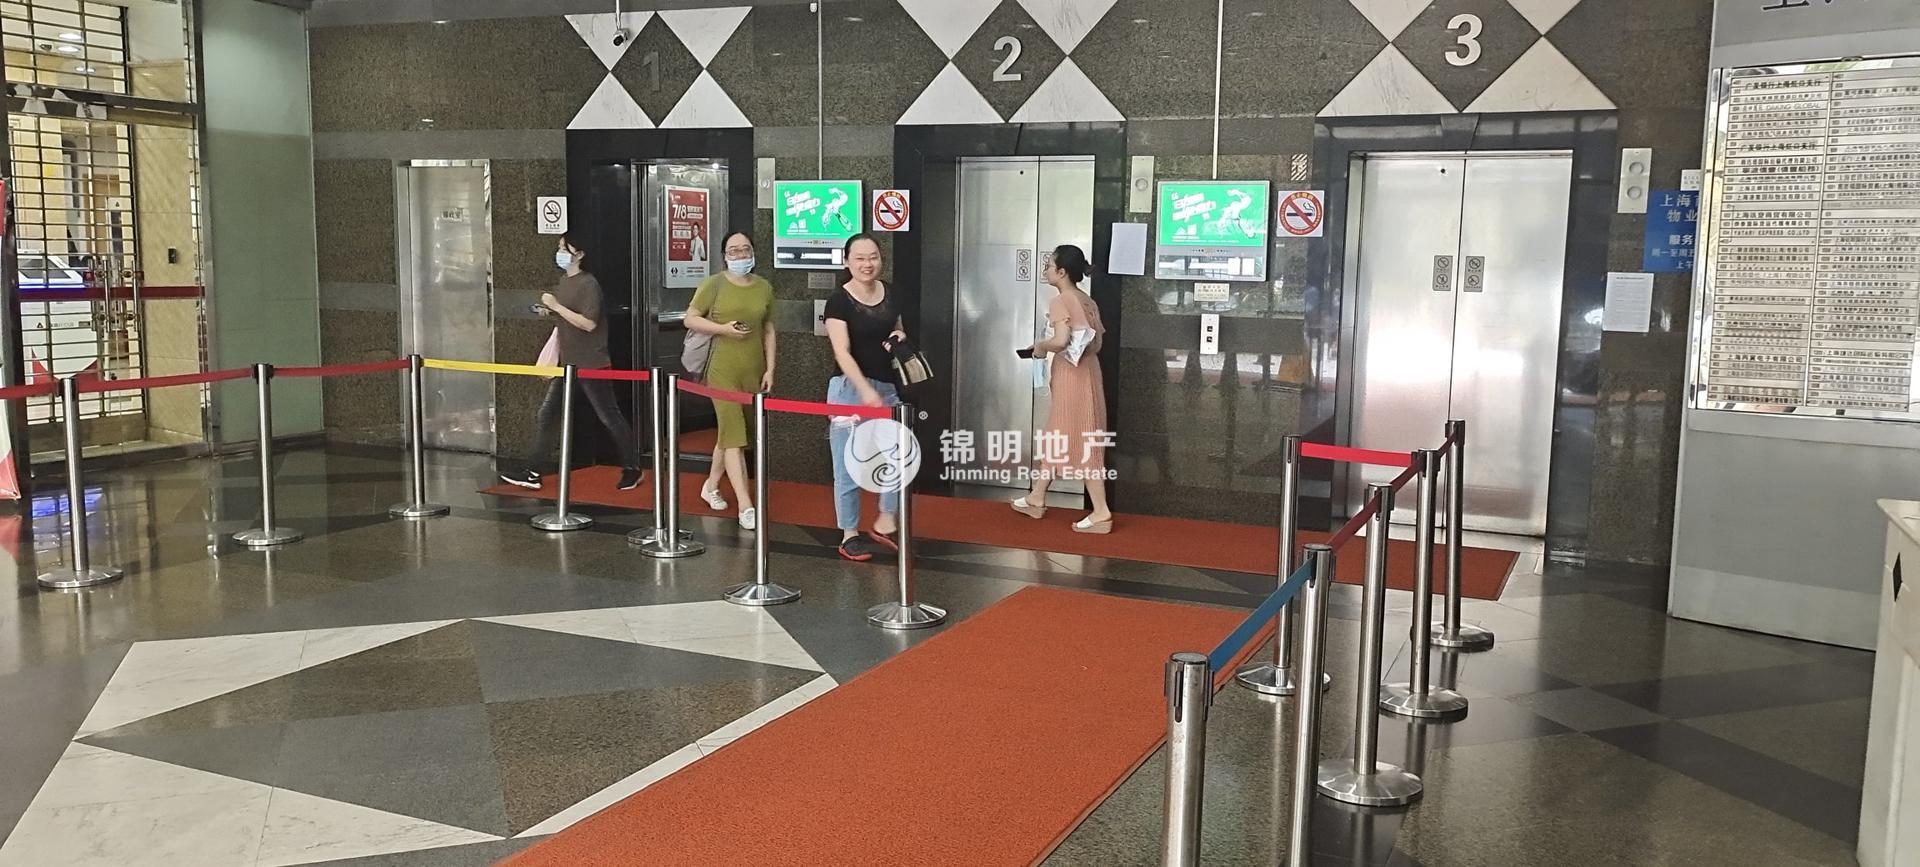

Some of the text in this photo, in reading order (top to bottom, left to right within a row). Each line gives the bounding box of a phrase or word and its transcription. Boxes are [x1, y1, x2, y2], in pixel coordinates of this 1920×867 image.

[993, 35, 1022, 82] 2
[1445, 13, 1483, 66] 3
[642, 51, 661, 93] 1
[1669, 234, 1693, 245] 服务
